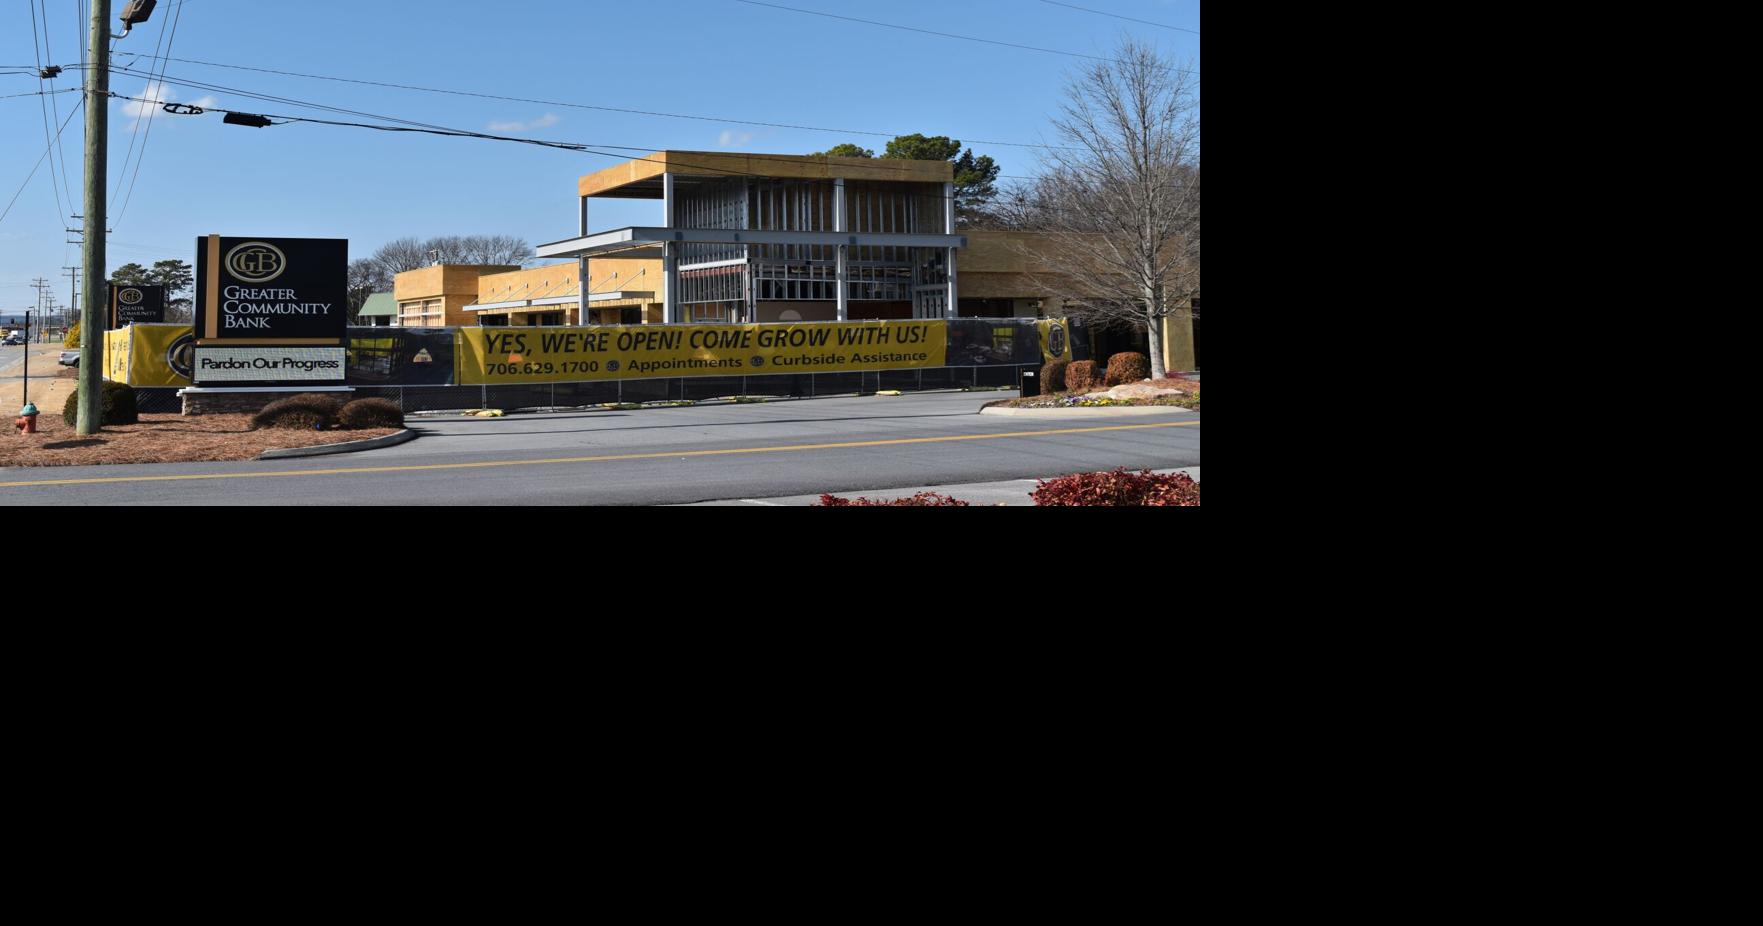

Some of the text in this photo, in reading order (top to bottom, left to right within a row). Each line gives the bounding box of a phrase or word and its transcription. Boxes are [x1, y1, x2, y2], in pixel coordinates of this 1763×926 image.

[485, 325, 929, 356] YES, WE'RE OPEN! COME GROW WITH US!
[200, 357, 340, 372] Pardon Our Progress
[486, 361, 599, 375] 706.629.1700
[627, 357, 743, 374] Appointments
[771, 352, 846, 366] Curbside
[850, 351, 928, 364] Assistance
